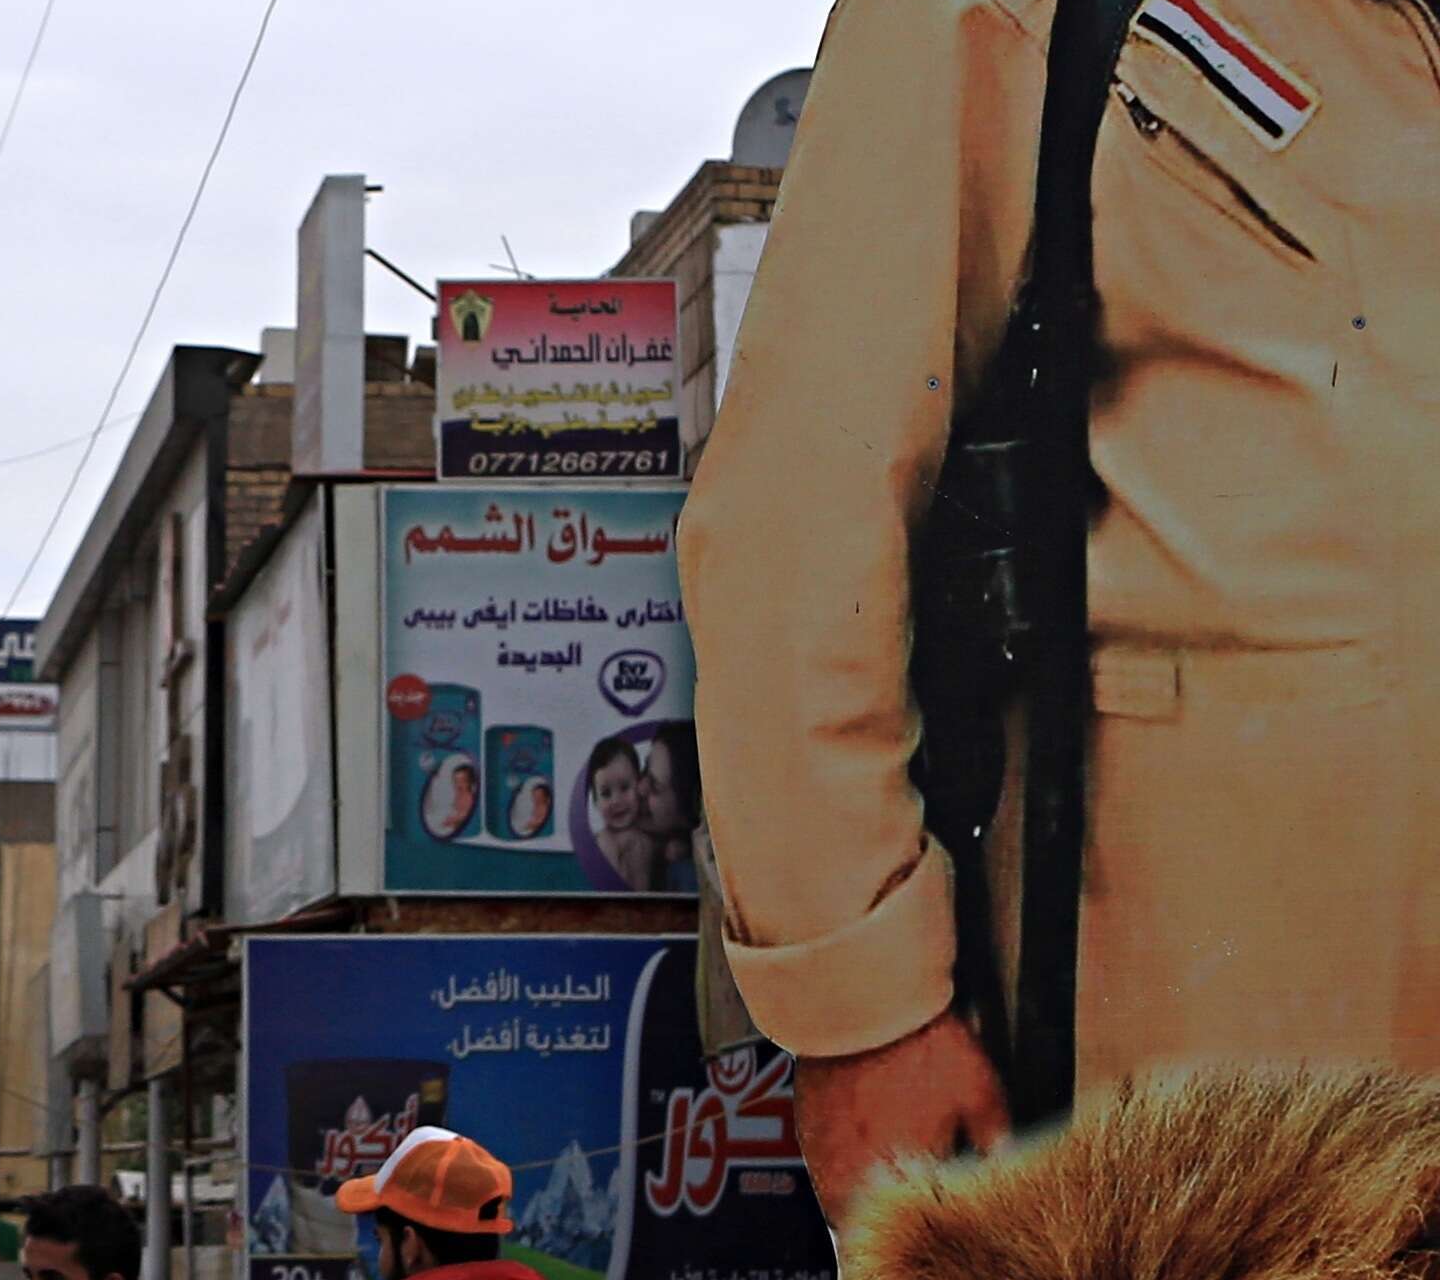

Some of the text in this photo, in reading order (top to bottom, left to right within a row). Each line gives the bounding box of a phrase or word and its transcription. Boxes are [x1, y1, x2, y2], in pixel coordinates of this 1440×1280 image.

[492, 333, 673, 370] غفران الحمداني
[470, 450, 668, 474] 07712667761
[546, 510, 678, 565] اسواق
[523, 598, 608, 623] حفاظات
[526, 975, 611, 1008] الحليب
[525, 1024, 611, 1058] لتغذية
